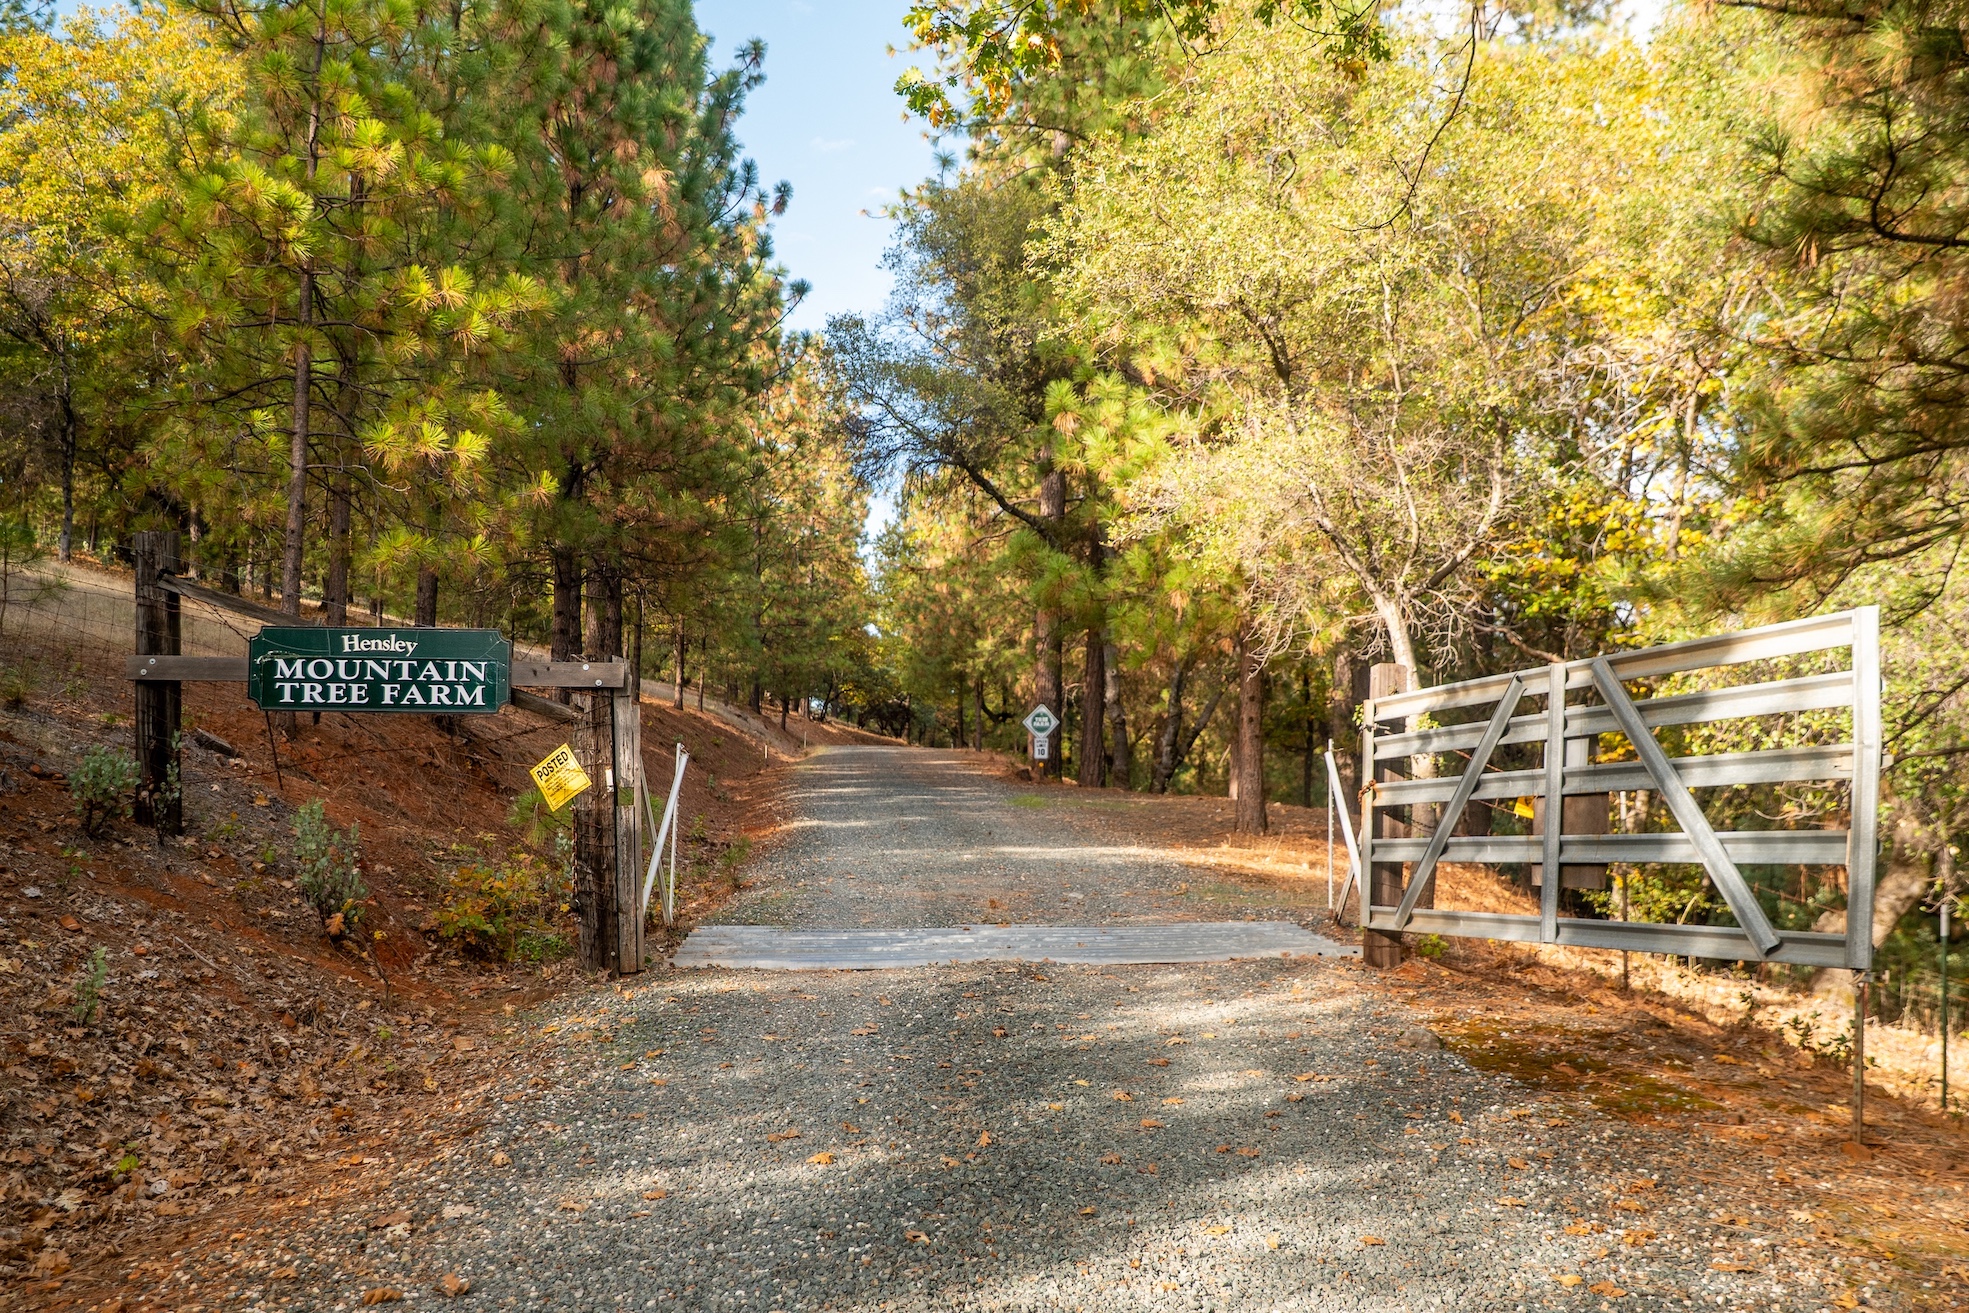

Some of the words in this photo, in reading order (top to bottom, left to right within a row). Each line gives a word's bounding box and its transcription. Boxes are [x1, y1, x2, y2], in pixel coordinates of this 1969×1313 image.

[342, 634, 419, 656] Hensley
[274, 658, 488, 682] MOUNTAIN
[275, 682, 370, 704] TREE
[381, 683, 486, 706] FARM
[536, 751, 569, 781] POSTED
